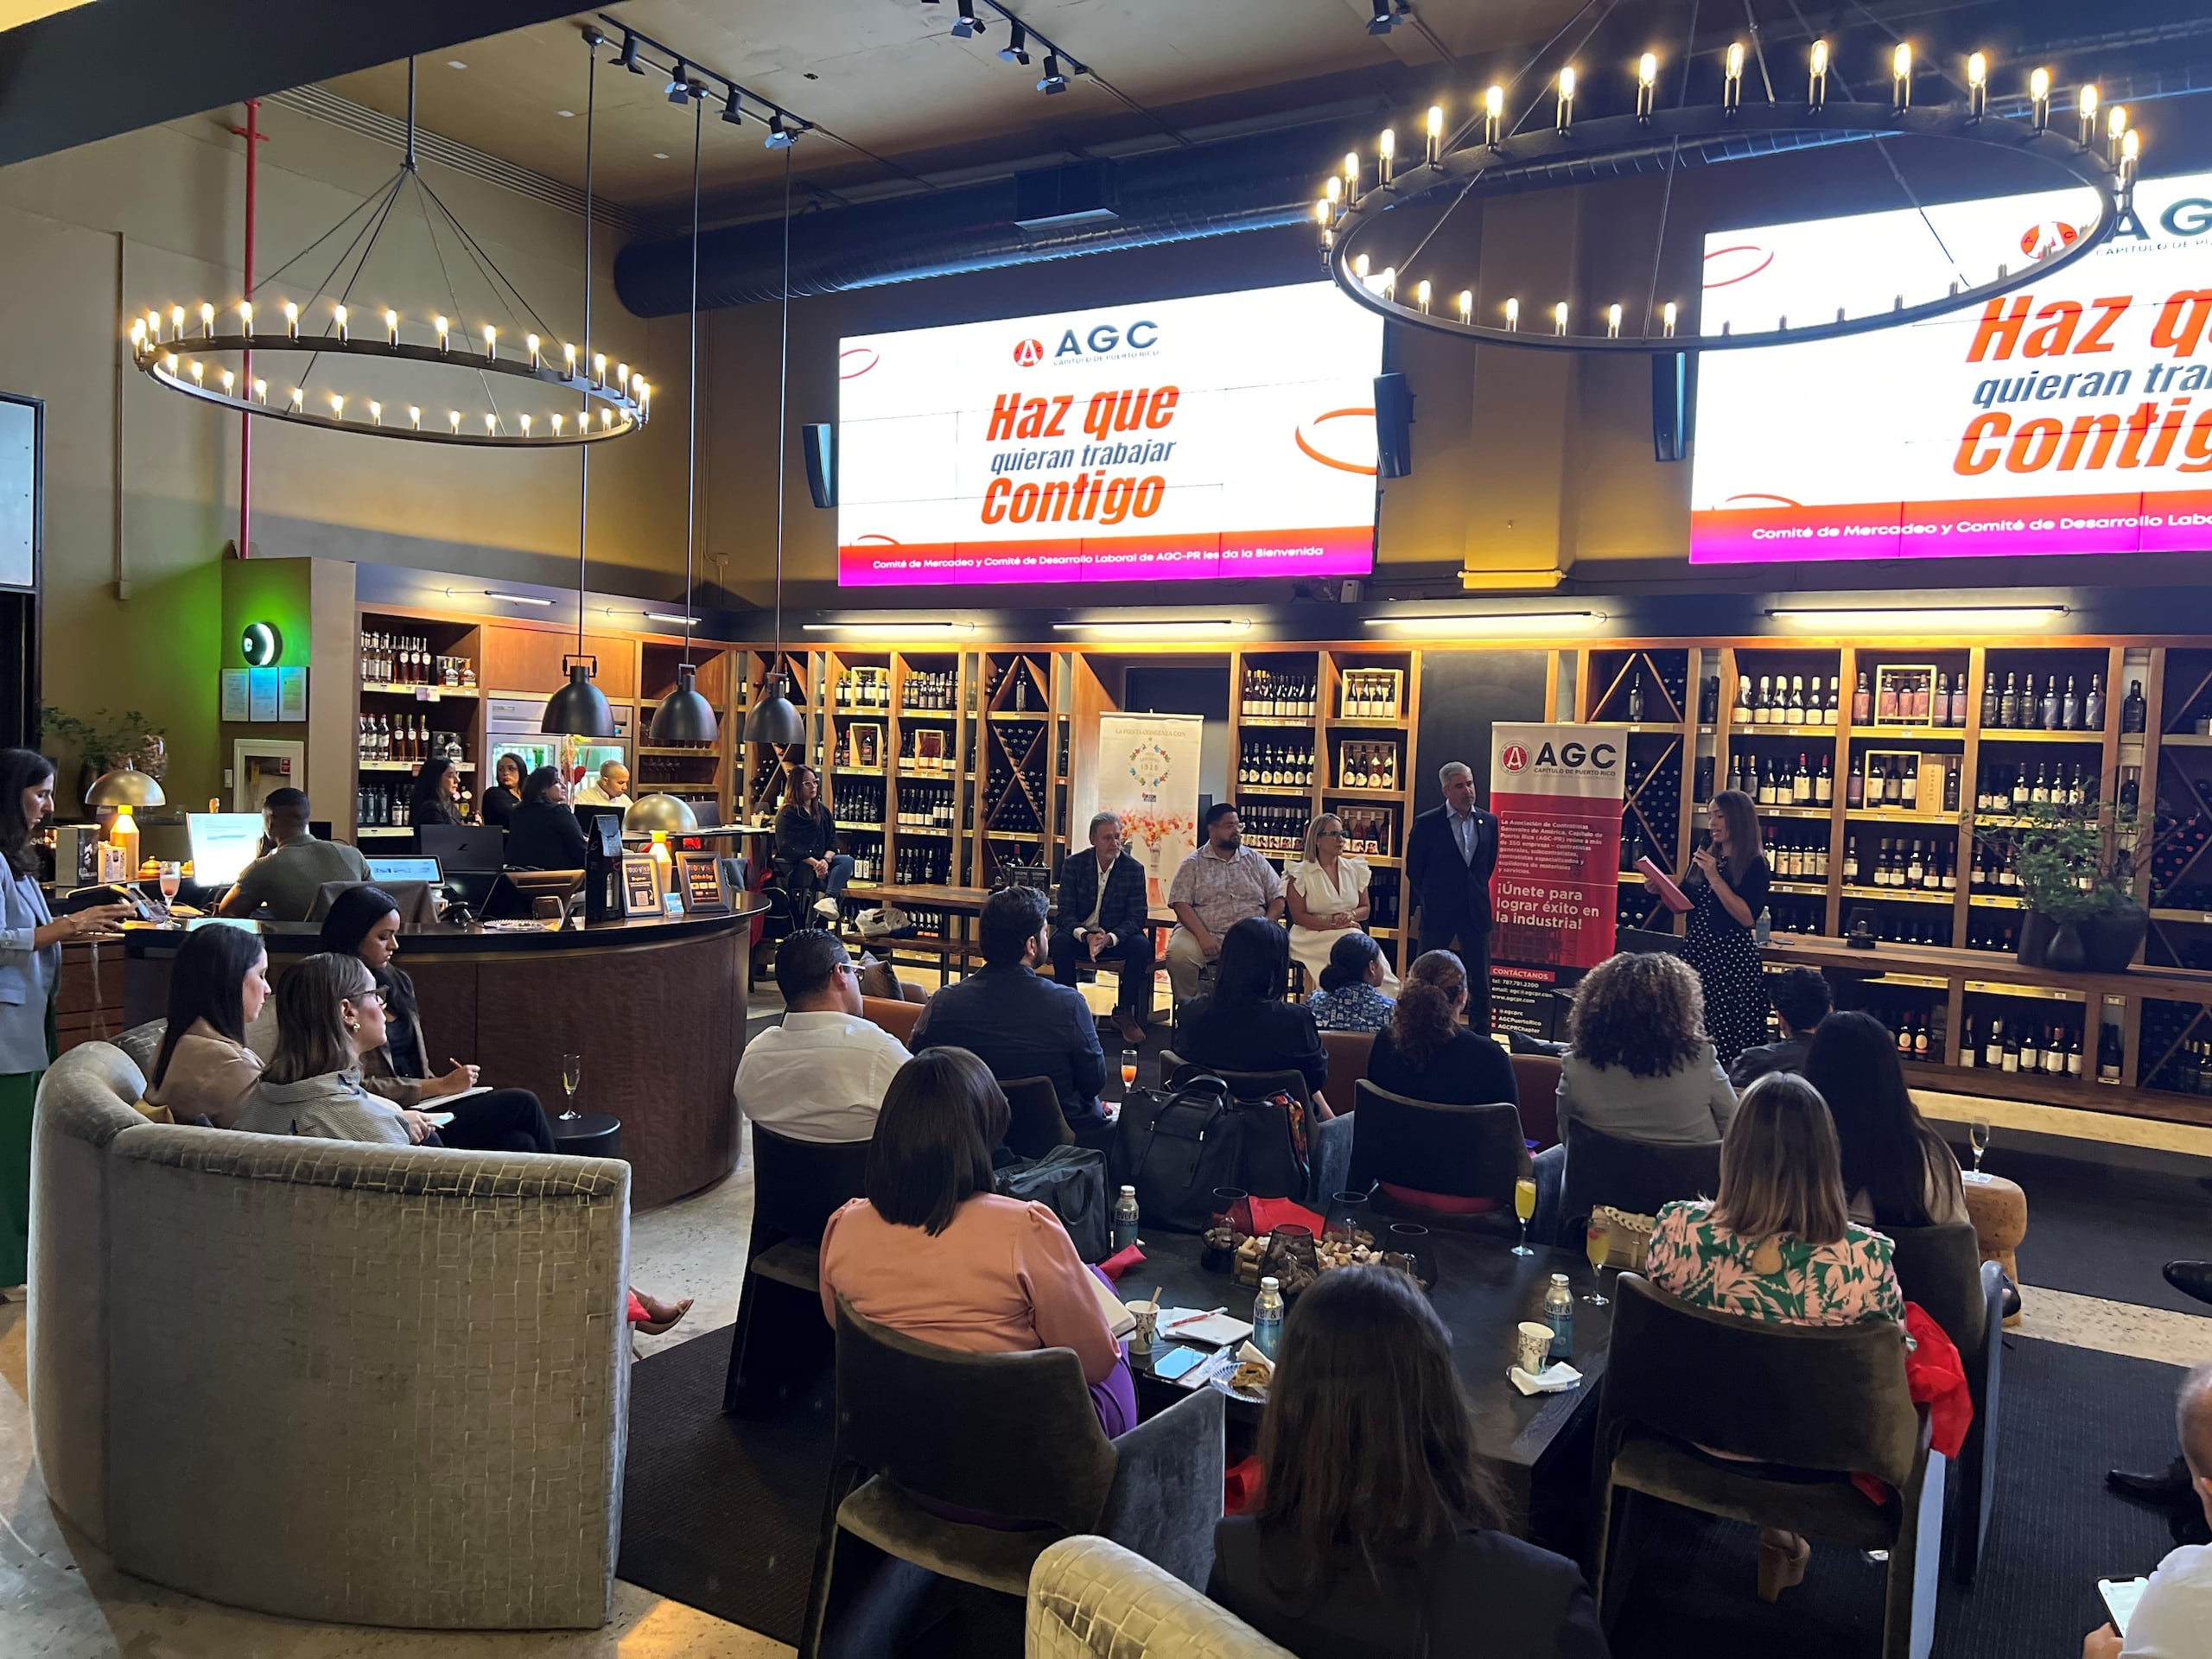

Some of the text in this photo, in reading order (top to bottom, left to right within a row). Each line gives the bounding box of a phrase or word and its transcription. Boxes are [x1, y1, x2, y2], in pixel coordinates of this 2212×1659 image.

[1054, 320, 1160, 358] AGC
[1966, 289, 2212, 363] Haz q
[1973, 369, 2133, 409] quieran
[986, 385, 1179, 442] Haz que
[990, 439, 1176, 475] quieran trabajar
[981, 469, 1166, 525] Contigo
[1751, 526, 1814, 540] Comité
[1816, 525, 1840, 537] de
[1843, 522, 1937, 537] Mercadeo
[1941, 524, 1953, 535] y
[1956, 518, 2025, 533] Comité
[2029, 518, 2055, 531] de
[2060, 515, 2163, 530] Desarrollo
[873, 545, 1324, 569] Comité de Mercadeo y Comité de Desarrollo Laboral de AGC-PR les da la Bienvenida
[1535, 741, 1617, 769] AGC
[1497, 882, 1583, 902] ¡Únete para
[1496, 912, 1583, 930] la industria!
[1497, 897, 1599, 917] lograr éxito en
[1492, 968, 1548, 980] CONTÁCTANOS
